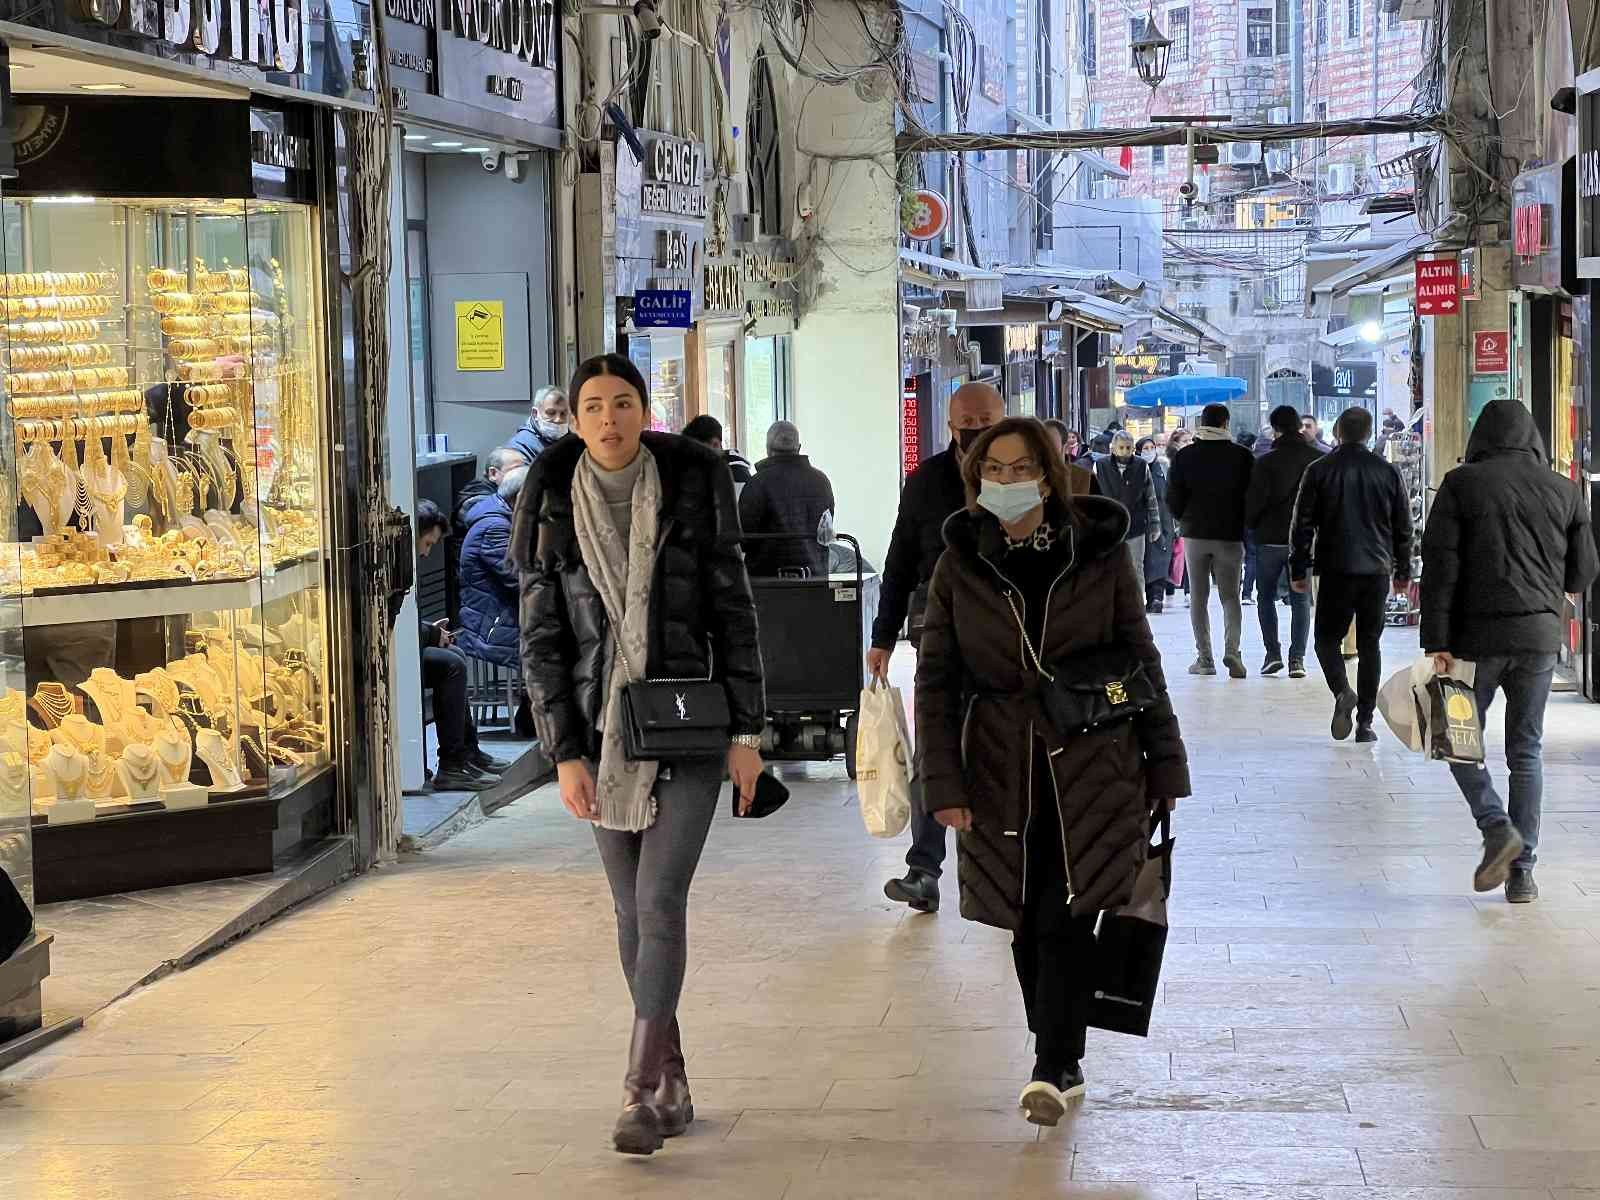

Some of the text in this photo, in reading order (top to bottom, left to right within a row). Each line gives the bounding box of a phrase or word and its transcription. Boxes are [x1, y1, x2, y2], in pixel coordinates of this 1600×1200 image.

[1581, 149, 1600, 198] HAS
[1420, 265, 1453, 278] ALTIN
[1418, 284, 1456, 297] ALINIR
[639, 294, 687, 309] GALİP
